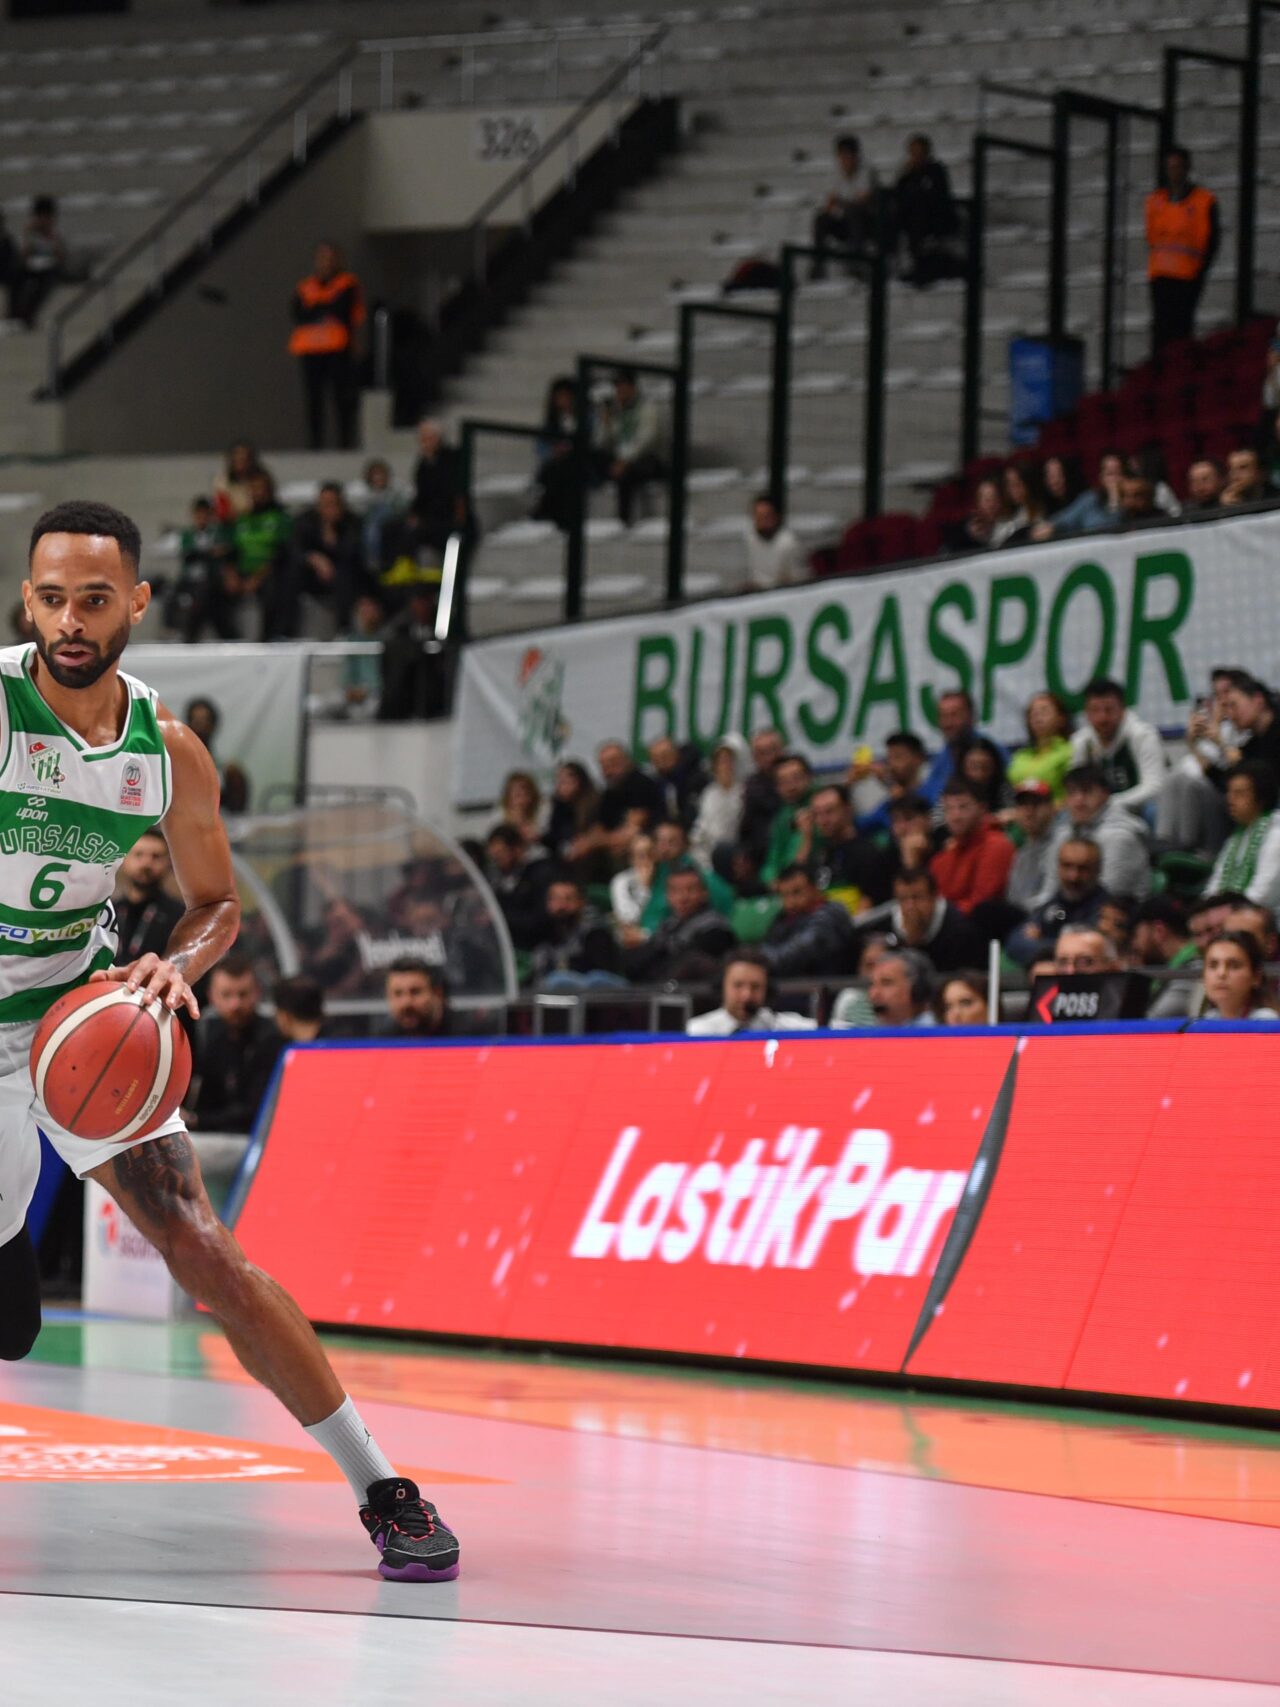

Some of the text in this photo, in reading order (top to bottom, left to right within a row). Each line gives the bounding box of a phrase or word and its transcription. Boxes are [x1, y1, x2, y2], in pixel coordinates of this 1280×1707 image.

[632, 551, 1195, 766] BURSASPOR
[16, 806, 49, 822] upon
[29, 862, 72, 910] 6
